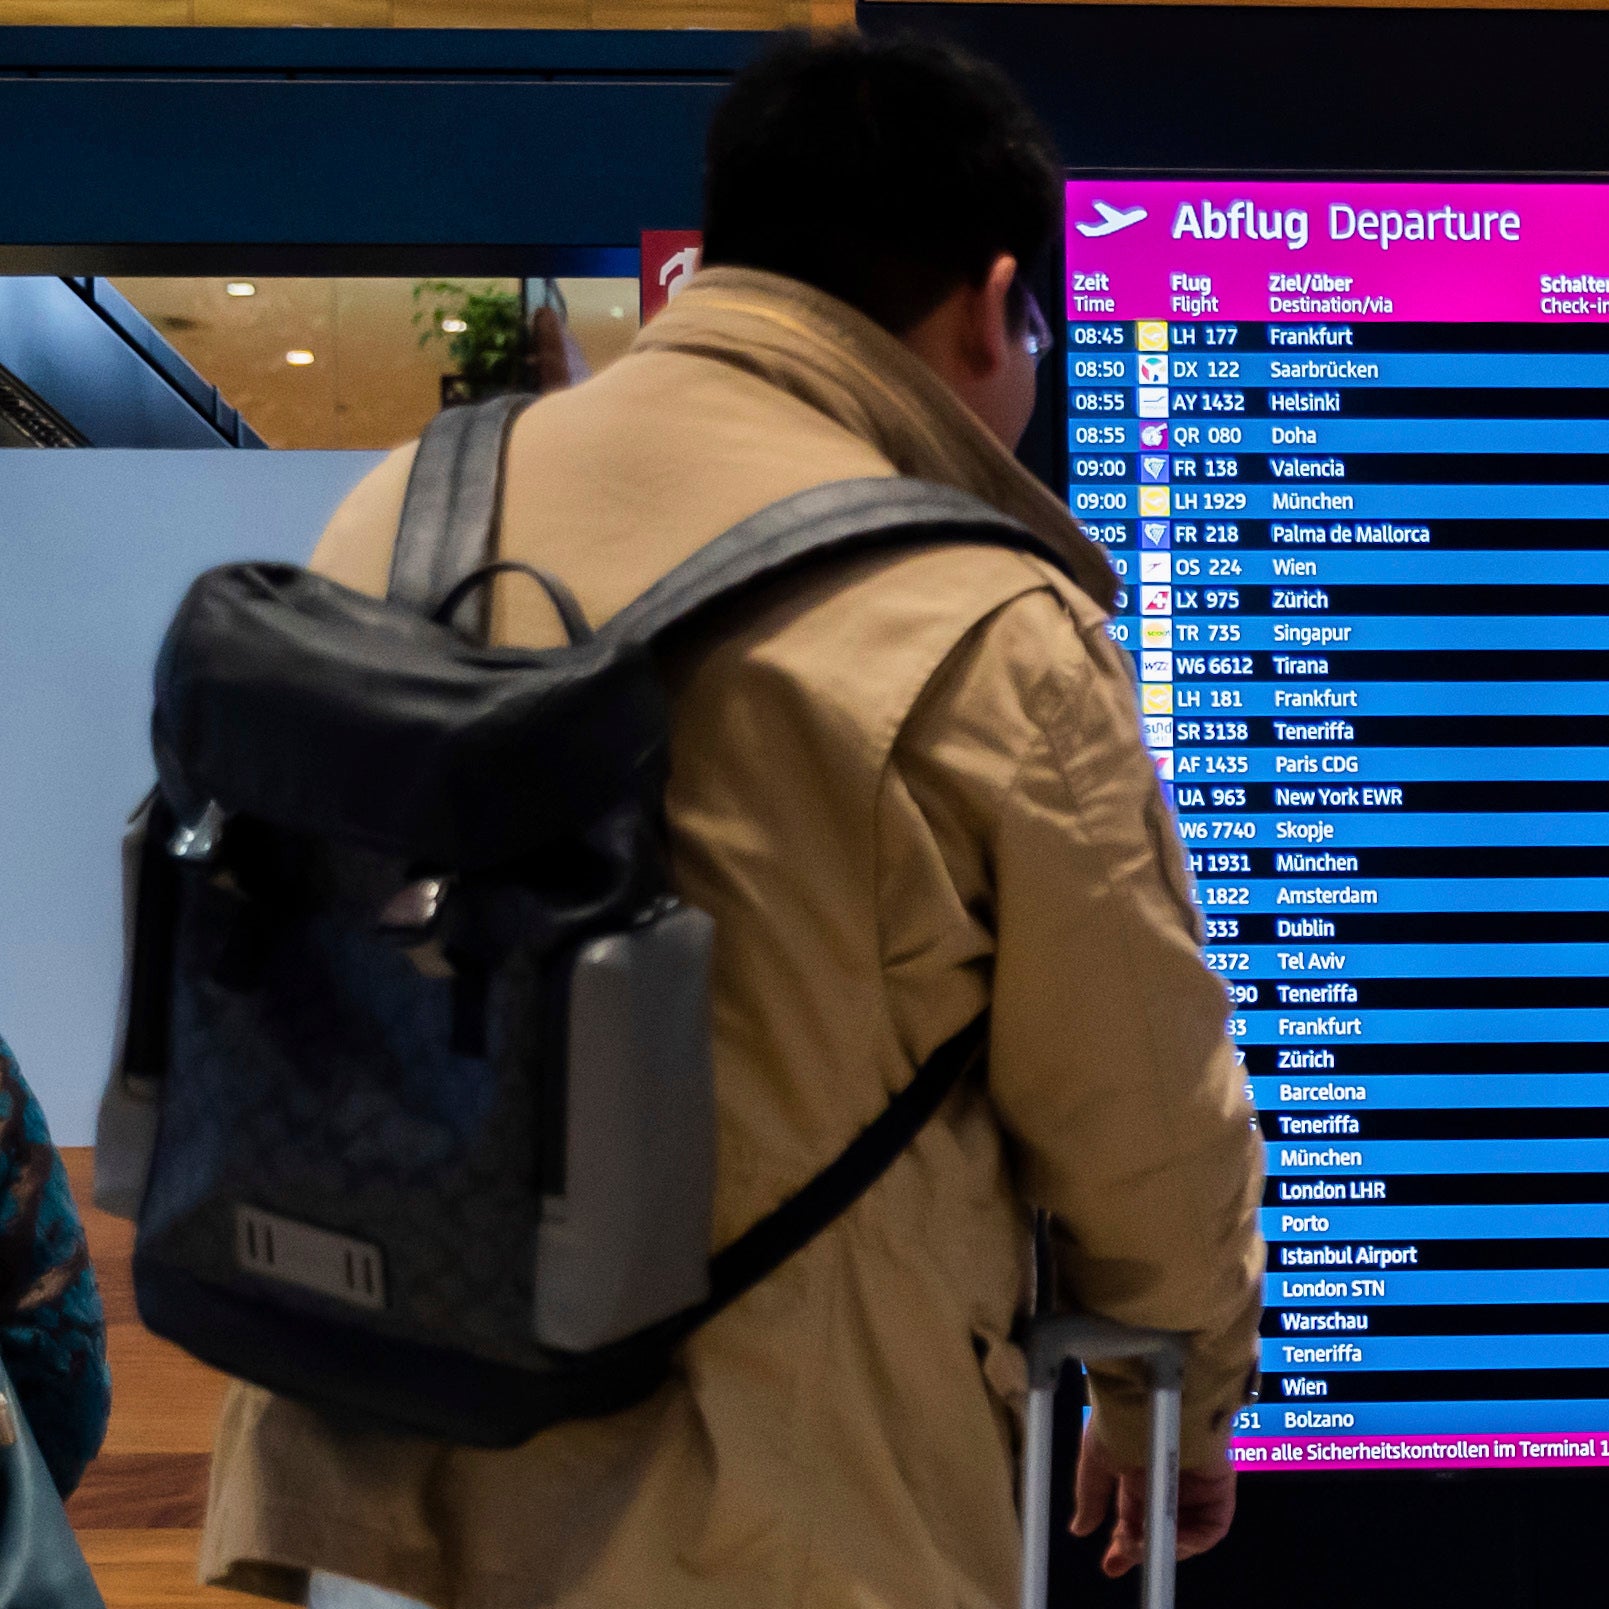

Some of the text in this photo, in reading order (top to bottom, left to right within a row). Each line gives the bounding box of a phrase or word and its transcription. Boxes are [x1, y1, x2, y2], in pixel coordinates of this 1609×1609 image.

[1172, 200, 1309, 250] Abflug
[1329, 204, 1521, 250] Departure
[1073, 272, 1110, 292] Zeit
[1170, 273, 1217, 299] Flug
[1268, 273, 1354, 294] Ziel/über
[1073, 294, 1115, 313] Time
[1171, 293, 1219, 317] Flight
[1269, 295, 1393, 315] Destination/via
[1074, 327, 1124, 345] 08:45
[1173, 328, 1196, 345] LH
[1205, 328, 1238, 345] 177
[1270, 326, 1353, 346] Frankfurt
[1075, 360, 1379, 379] 08:50 DX 122 Saarbrücken
[1075, 393, 1125, 411] 08:55
[1172, 394, 1198, 411] AY
[1202, 393, 1245, 411] 1432
[1271, 393, 1340, 412] Helsinki
[1075, 426, 1317, 447] 08:55 QR 080 Doha
[1273, 524, 1326, 543] Palma
[1330, 524, 1353, 543] de
[1355, 524, 1430, 543] Mallorca
[1273, 623, 1352, 646] Singapur
[1276, 820, 1334, 843] Skopje
[1278, 918, 1335, 938] Dublin
[1281, 1214, 1330, 1233] Porto
[1281, 1311, 1368, 1331] Warschau
[1270, 1443, 1304, 1460] alle
[1306, 1440, 1490, 1461] Sicherheitskontrollen
[1493, 1439, 1516, 1458] im
[1518, 1438, 1596, 1458] Terminal
